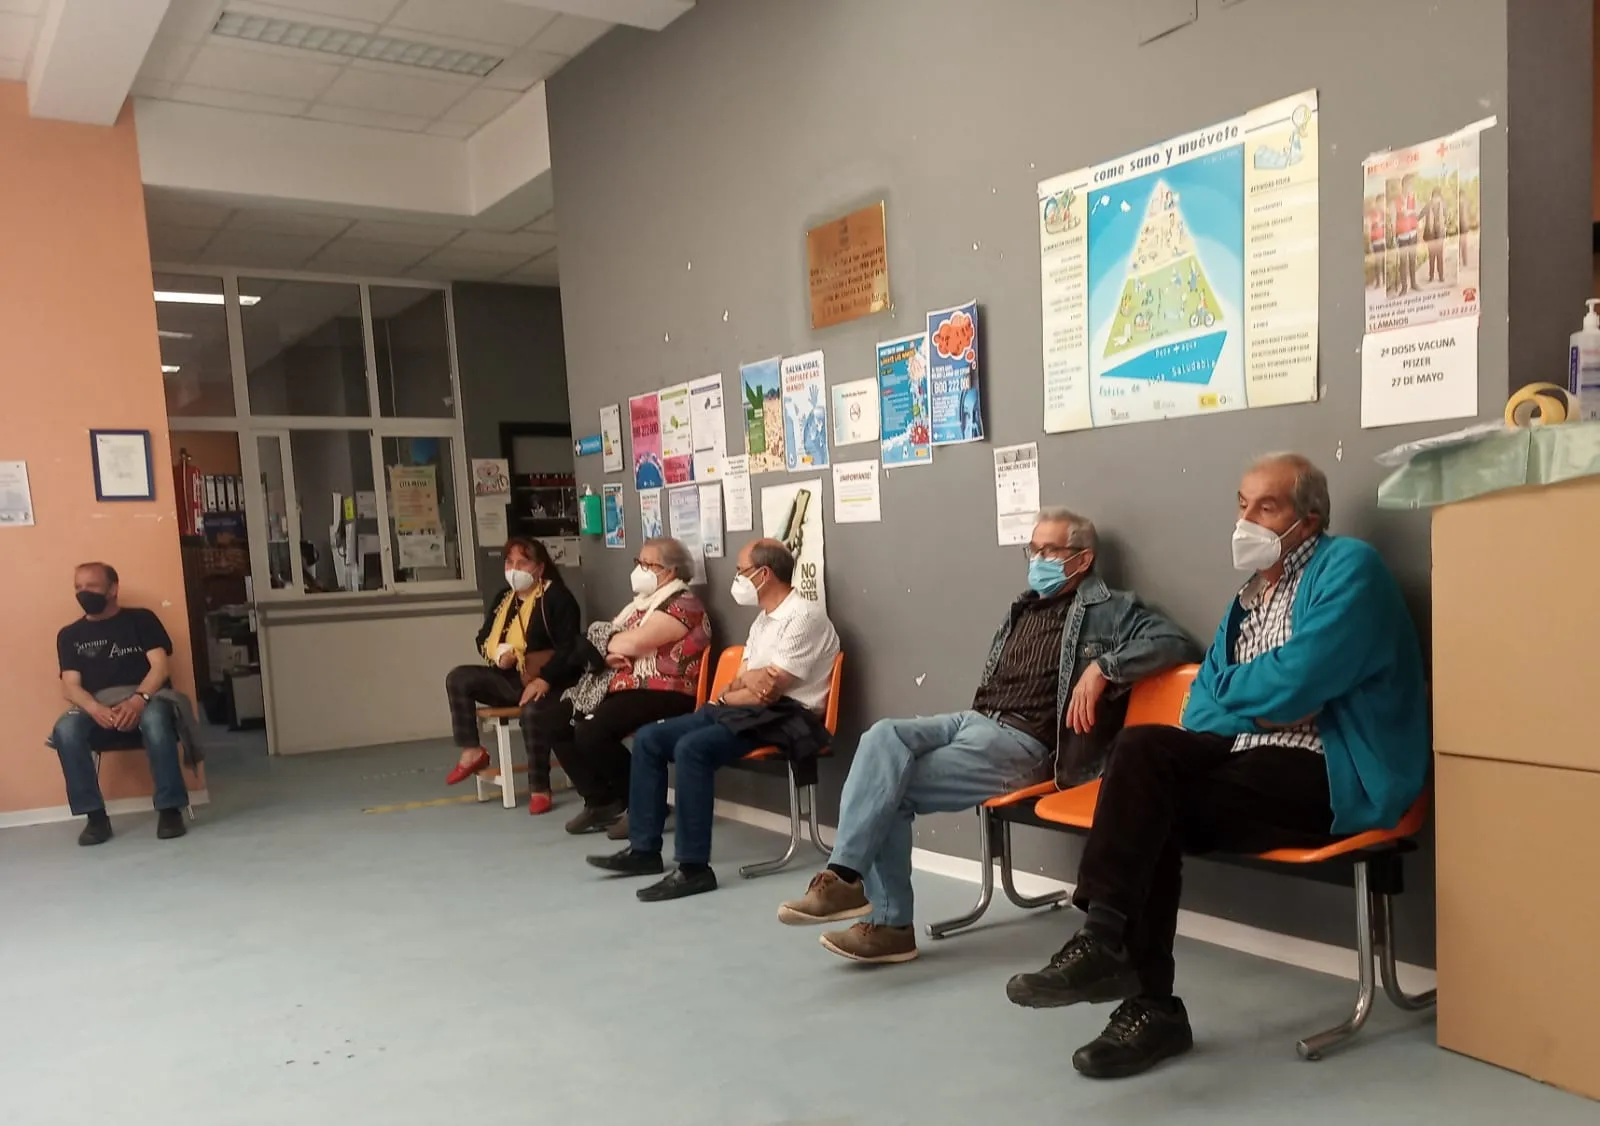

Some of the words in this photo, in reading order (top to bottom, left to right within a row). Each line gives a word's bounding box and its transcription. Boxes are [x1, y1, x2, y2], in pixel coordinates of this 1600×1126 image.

[1093, 163, 1125, 183] come
[1130, 152, 1160, 171] sano
[1166, 146, 1173, 165] y
[1178, 125, 1239, 156] muévete
[1423, 293, 1436, 303] para
[1391, 344, 1416, 356] DOSIS
[1418, 337, 1456, 352] VACUNA
[785, 364, 801, 374] SALVA
[1402, 356, 1431, 369] PFIZER
[1391, 377, 1401, 388] 27
[1403, 375, 1414, 386] DE
[1416, 372, 1444, 384] MAYO
[785, 383, 805, 393] MANOS
[801, 562, 816, 579] NO
[801, 579, 817, 590] CON
